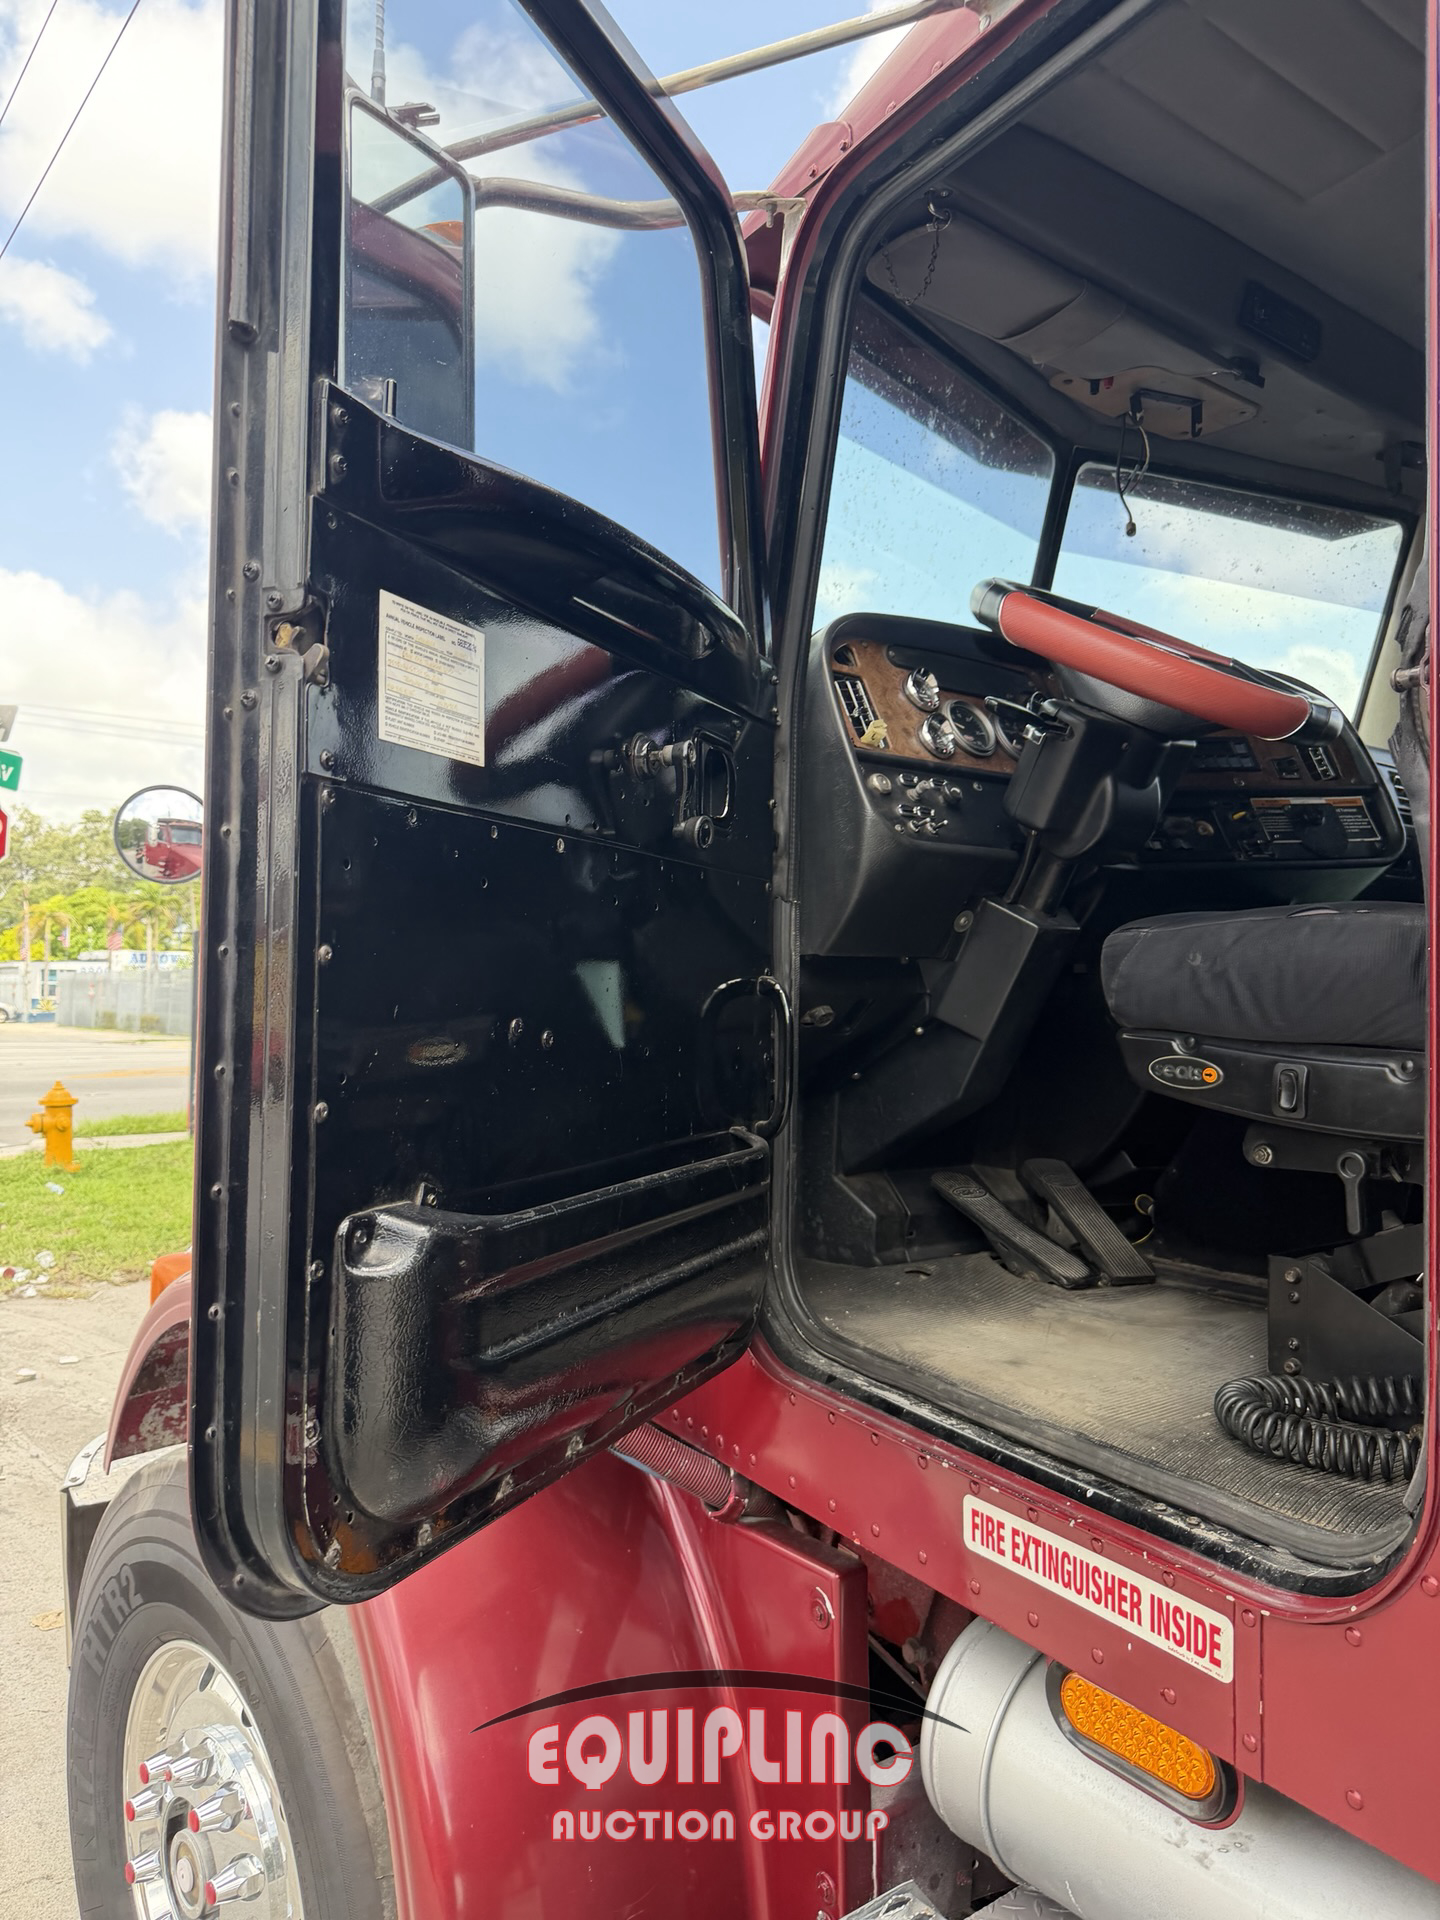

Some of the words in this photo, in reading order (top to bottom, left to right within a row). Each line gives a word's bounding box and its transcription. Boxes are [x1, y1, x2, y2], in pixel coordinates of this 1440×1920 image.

[1154, 1064, 1202, 1081] seats
[81, 1563, 145, 1676] HTR2
[971, 1508, 1006, 1558] FIRE
[1011, 1527, 1143, 1627] EXTINGUISHER
[1150, 1593, 1222, 1669] INSIDE
